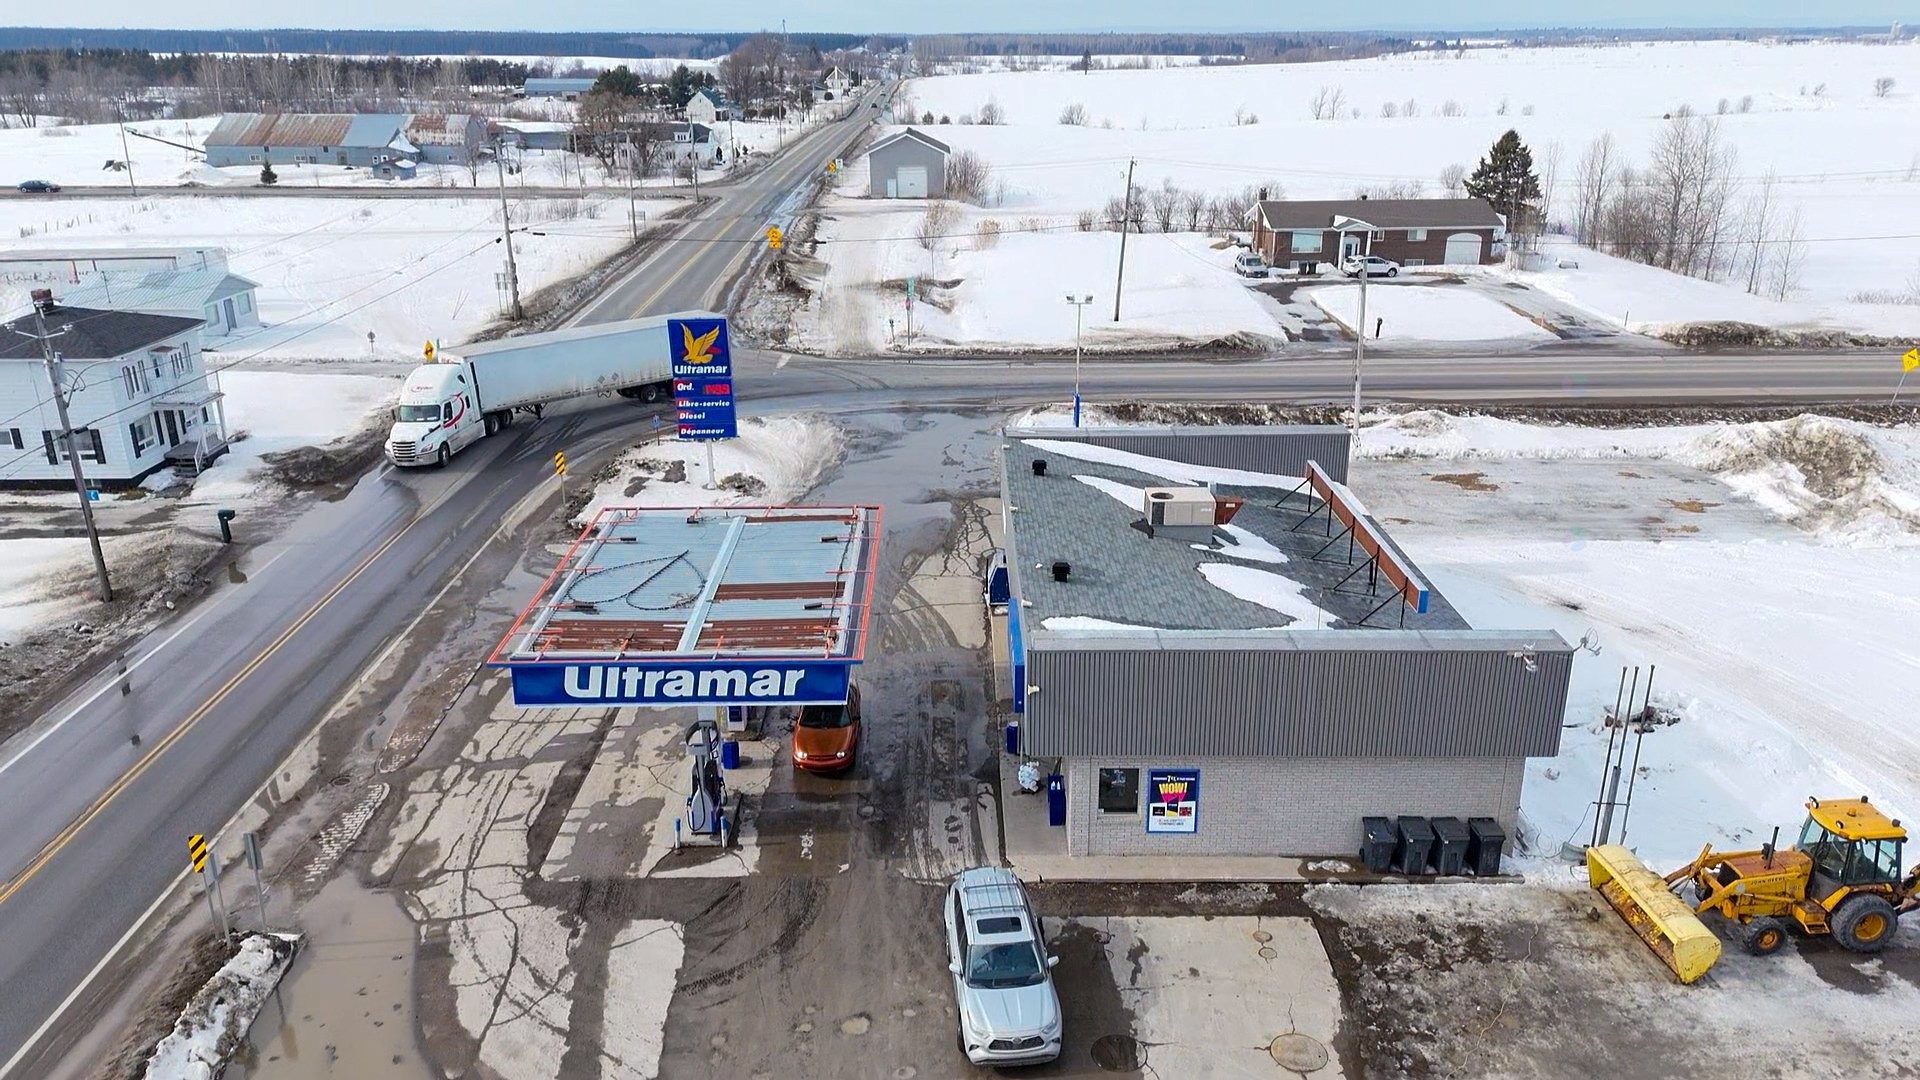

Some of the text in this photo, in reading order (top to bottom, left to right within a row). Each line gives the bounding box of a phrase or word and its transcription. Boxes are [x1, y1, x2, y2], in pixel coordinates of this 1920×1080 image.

[675, 365, 727, 374] Ultramar
[677, 383, 694, 391] Ord.
[564, 666, 805, 698] Ultramar
[1158, 782, 1188, 794] WOW!
